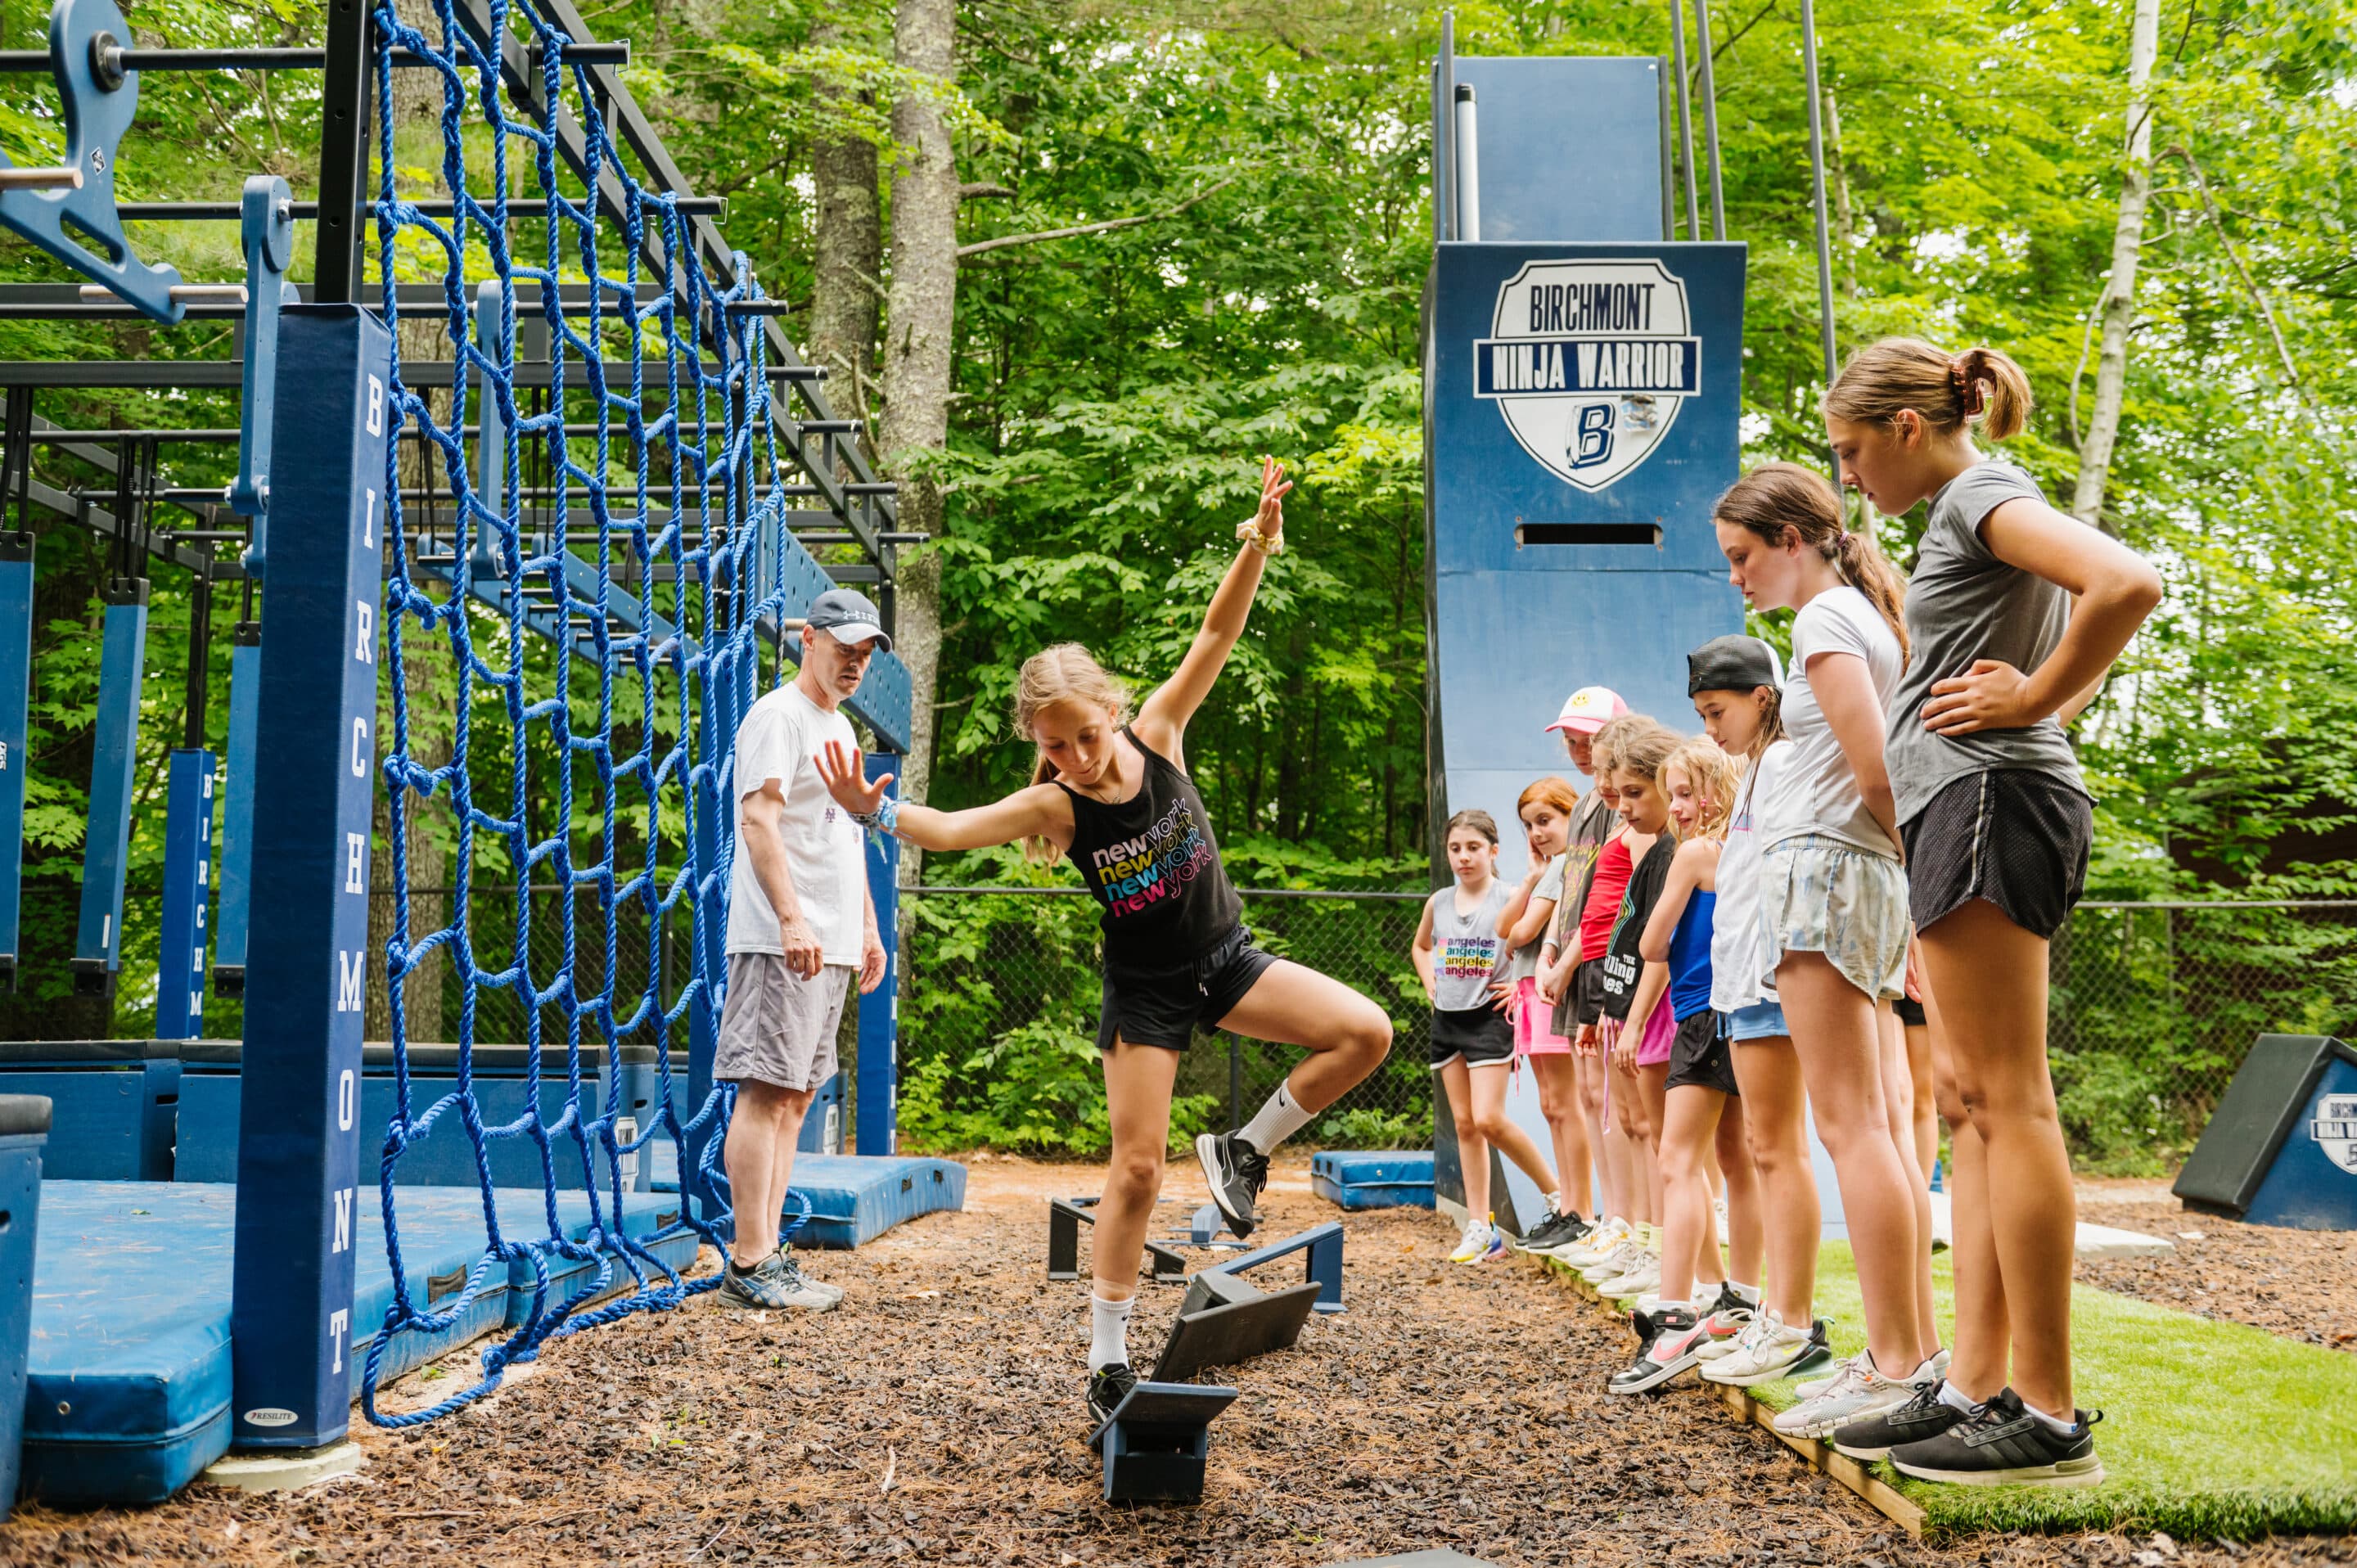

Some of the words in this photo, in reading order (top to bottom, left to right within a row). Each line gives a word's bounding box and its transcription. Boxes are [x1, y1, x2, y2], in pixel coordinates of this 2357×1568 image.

[1530, 283, 1656, 332] BIRCHMONT
[1492, 344, 1566, 390] NINJA
[1577, 342, 1683, 389] WARRIOR
[1566, 401, 1616, 471] B
[330, 372, 383, 1375] BIRCHMONT
[189, 773, 214, 1039] BIRCHM
[1623, 953, 1636, 966] THE
